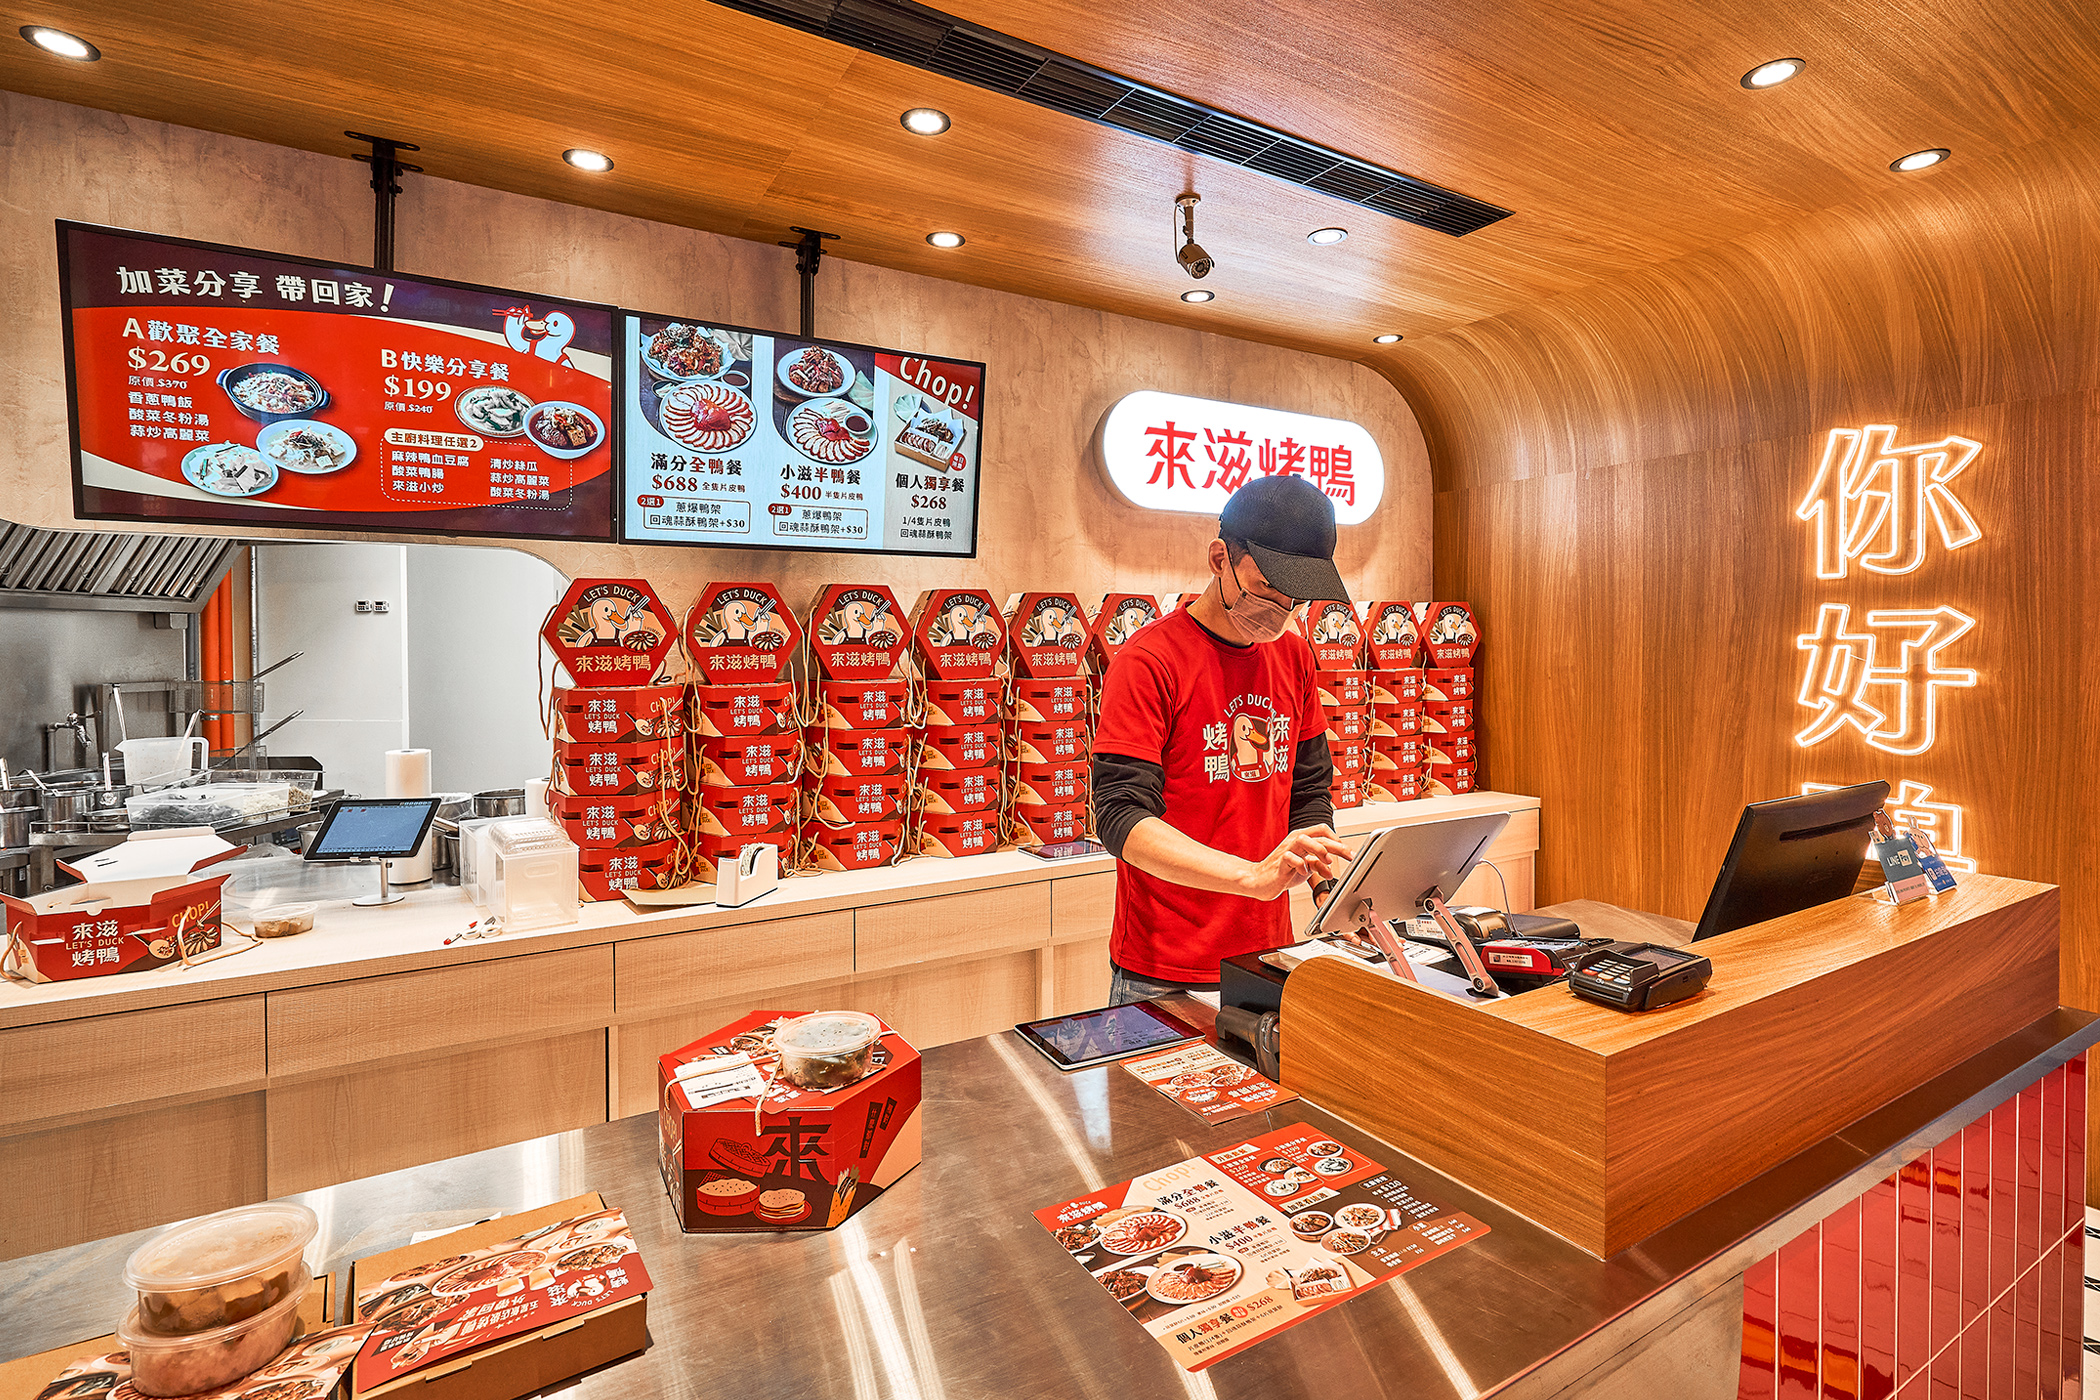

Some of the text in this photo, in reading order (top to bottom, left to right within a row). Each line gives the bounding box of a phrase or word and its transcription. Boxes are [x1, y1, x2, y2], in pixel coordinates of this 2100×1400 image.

[116, 267, 262, 299] 加菜分享
[128, 346, 210, 377] $269
[128, 376, 154, 388] 原價
[384, 374, 451, 402] $199
[900, 357, 974, 410] Chop!
[384, 401, 406, 411] 原價
[128, 408, 209, 427] 酸菜冬粉湯
[130, 425, 210, 442] 蒜炒高麗菜
[391, 432, 478, 449] 主廚料理任選2
[392, 451, 469, 467] 麻辣鴨血豆腐
[490, 458, 538, 472] 清炒絲瓜
[651, 453, 742, 476] 滿分全鴨餐
[1144, 421, 1355, 506] 來滋烤鴨
[490, 473, 550, 487] 蒜炒高麗菜
[780, 464, 861, 485] 小滋半鴨餐
[392, 481, 444, 493] 來滋小炒
[651, 474, 746, 493] $688 全隻片皮鴨
[895, 473, 965, 493] 個人獨享餐
[490, 487, 550, 501] 酸菜冬粉湯
[781, 484, 821, 500] $400
[911, 495, 946, 510] $268
[584, 586, 640, 602] LET'S DUCK
[744, 590, 767, 605] DUCK
[862, 591, 883, 605] DUCK
[965, 595, 983, 609] DUCK
[576, 654, 651, 672] 來滋烤鴨
[709, 654, 776, 670] 來滋烤鴨
[831, 652, 890, 667] 來滋烤鴨
[940, 652, 991, 667] 來滋烤鴨
[1032, 652, 1077, 666] 來滋烤鴨
[734, 695, 760, 708] 來滋
[863, 691, 886, 702] 來滋
[588, 699, 616, 713] 來滋
[1224, 695, 1243, 718] LET'S
[734, 715, 760, 727] 烤鴨
[863, 709, 886, 720] 烤鴨
[588, 720, 617, 733] 烤鴨
[862, 737, 885, 749] 來滋
[1274, 714, 1290, 773] 來滋
[746, 745, 771, 757] 來滋
[1203, 721, 1229, 784] 烤鴨
[590, 752, 617, 766] 來滋
[861, 756, 885, 768] 烤鴨
[745, 764, 771, 777] 烤鴨
[589, 773, 618, 786] 烤鴨
[743, 794, 768, 807] 來滋
[587, 806, 615, 819] 來滋
[742, 813, 768, 826] 烤鴨
[586, 827, 615, 840] 烤鴨
[609, 856, 638, 871] 來滋
[1887, 855, 1900, 866] LINE
[609, 877, 638, 891] 烤鴨
[72, 920, 118, 940] 來滋
[66, 937, 124, 950] LET'S DUCK
[72, 947, 120, 967] 烤鴨
[762, 1117, 832, 1185] 來
[1142, 1162, 1195, 1191] Chop!
[1157, 1180, 1219, 1205] 滿分全鴨餐
[1174, 1196, 1200, 1209] $688
[1209, 1216, 1271, 1244] 小滋半鴨餐
[1225, 1236, 1253, 1250] $400
[458, 1294, 526, 1321] 外帶回家
[571, 1299, 593, 1307] DUCK
[1247, 1296, 1273, 1311] $268
[1176, 1313, 1234, 1344] 個人獨享餐
